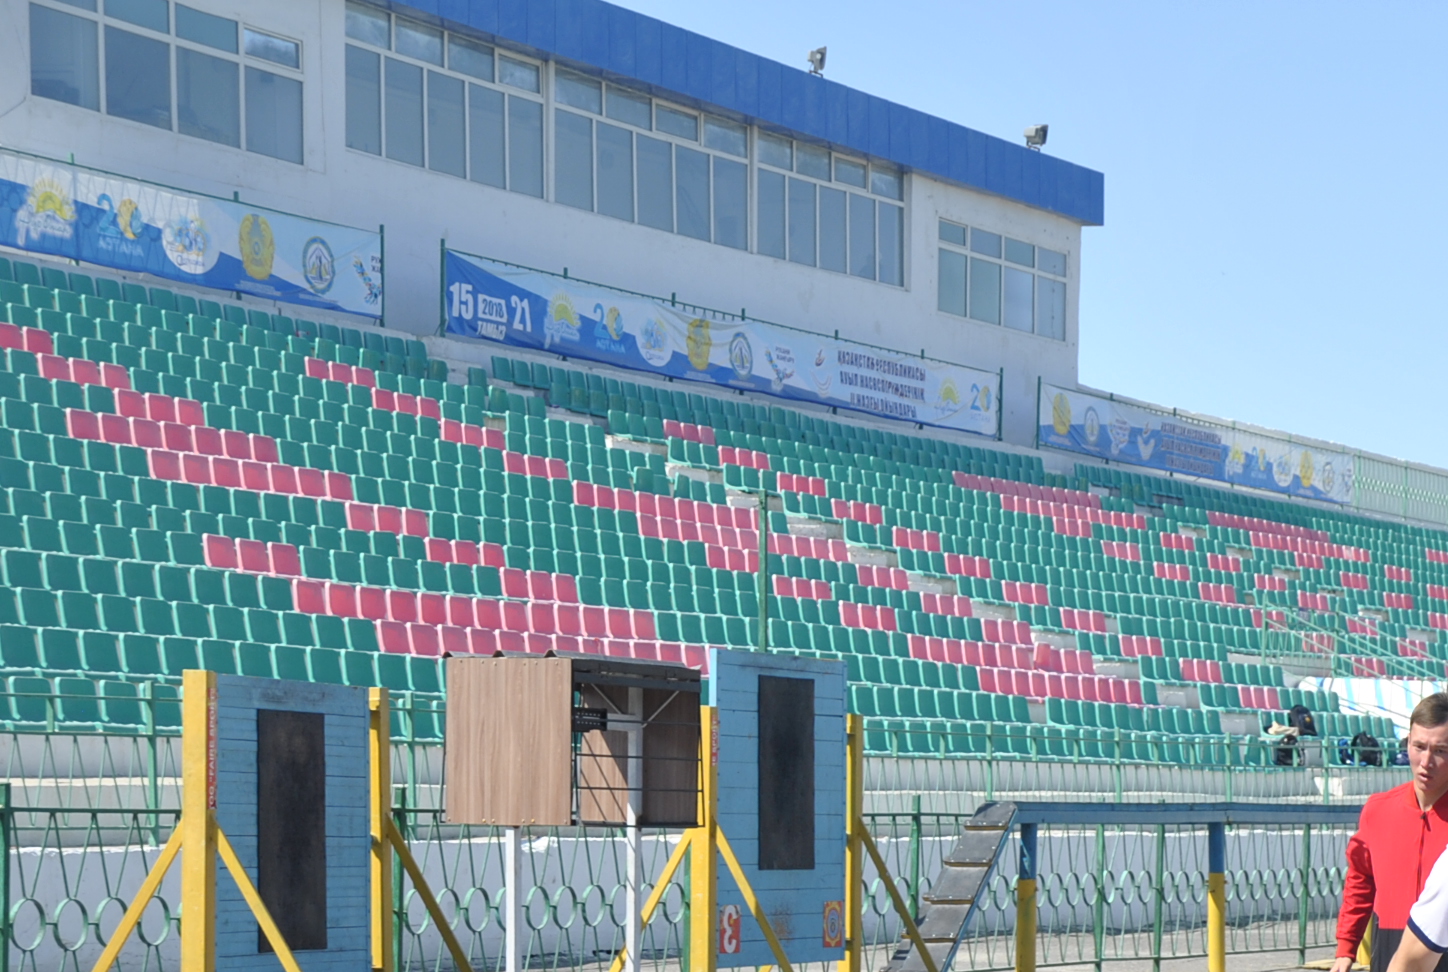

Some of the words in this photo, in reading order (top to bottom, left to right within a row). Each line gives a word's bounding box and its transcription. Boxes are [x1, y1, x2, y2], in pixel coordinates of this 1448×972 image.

[449, 282, 474, 320] 15
[481, 298, 505, 319] 2018
[510, 295, 532, 333] 21
[476, 320, 507, 341] ТАМЫЗ
[840, 370, 859, 387] АУЫЛ
[723, 904, 738, 954] 3
